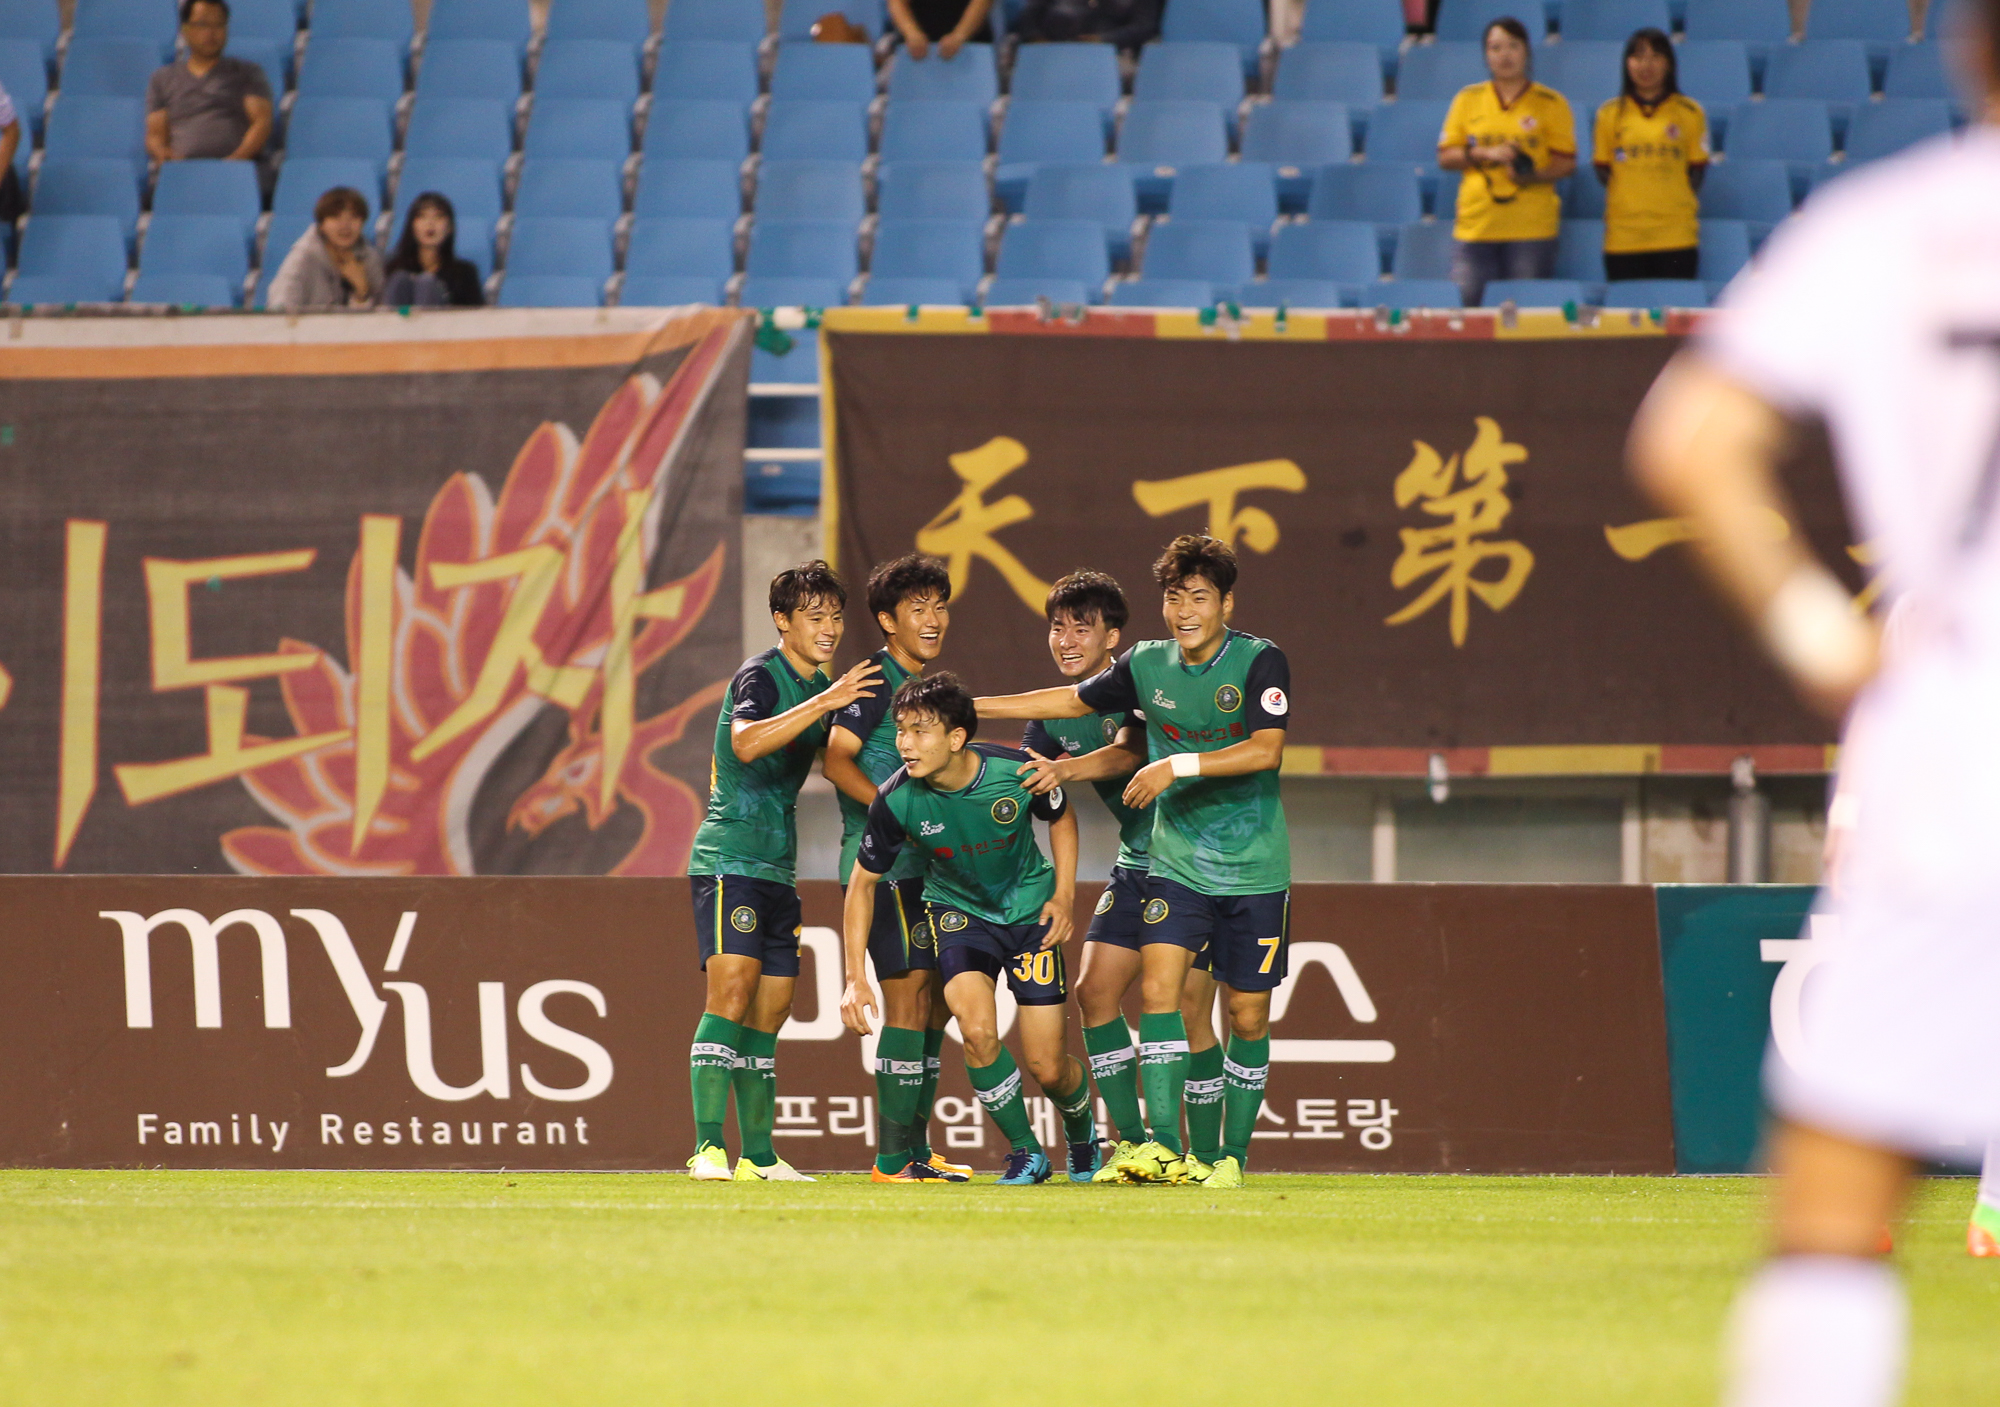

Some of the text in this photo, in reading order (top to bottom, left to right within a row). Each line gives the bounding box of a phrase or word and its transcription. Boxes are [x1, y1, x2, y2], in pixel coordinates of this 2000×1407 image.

[1012, 949, 1056, 986] 30
[1257, 936, 1281, 974] 7
[137, 1113, 589, 1153] Family Restaurant
[771, 1095, 984, 1148] 프리엄
